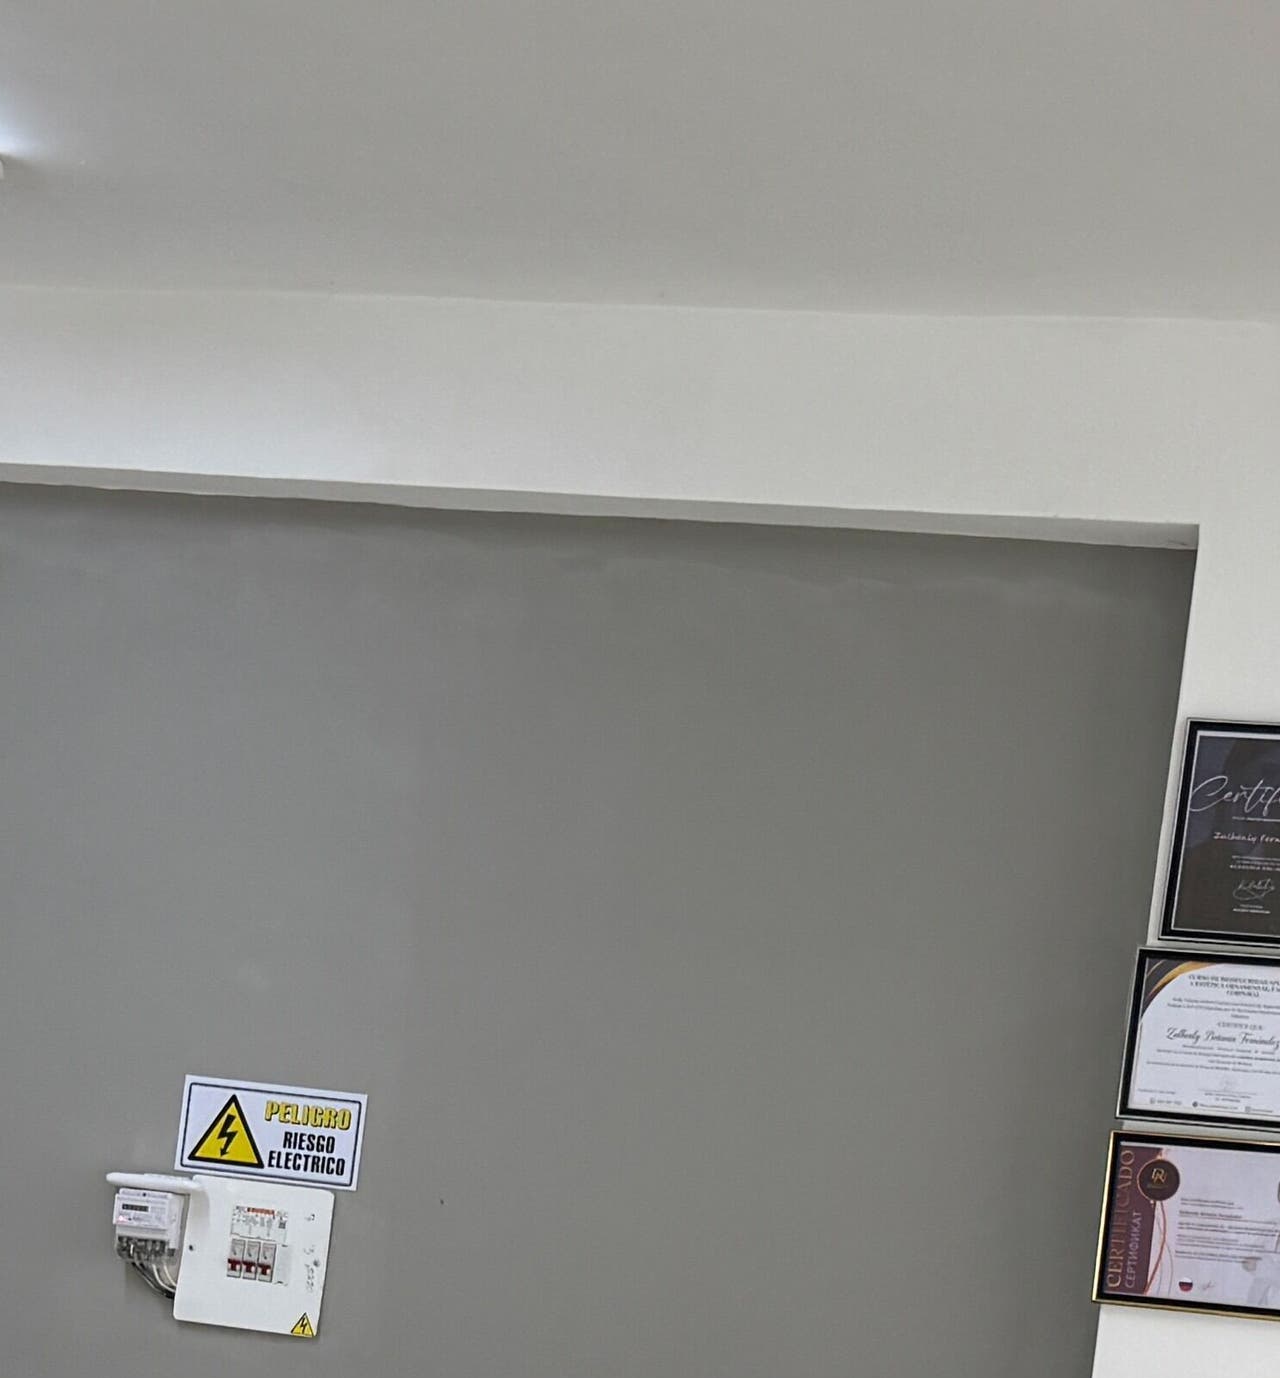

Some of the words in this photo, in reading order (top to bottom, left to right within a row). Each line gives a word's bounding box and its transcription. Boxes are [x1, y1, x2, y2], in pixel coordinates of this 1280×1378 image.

[264, 1100, 352, 1131] PELIGRO
[283, 1131, 336, 1154] RIESGO
[267, 1150, 346, 1176] ELECTRICO
[1107, 1150, 1136, 1289] CERTIFICADO
